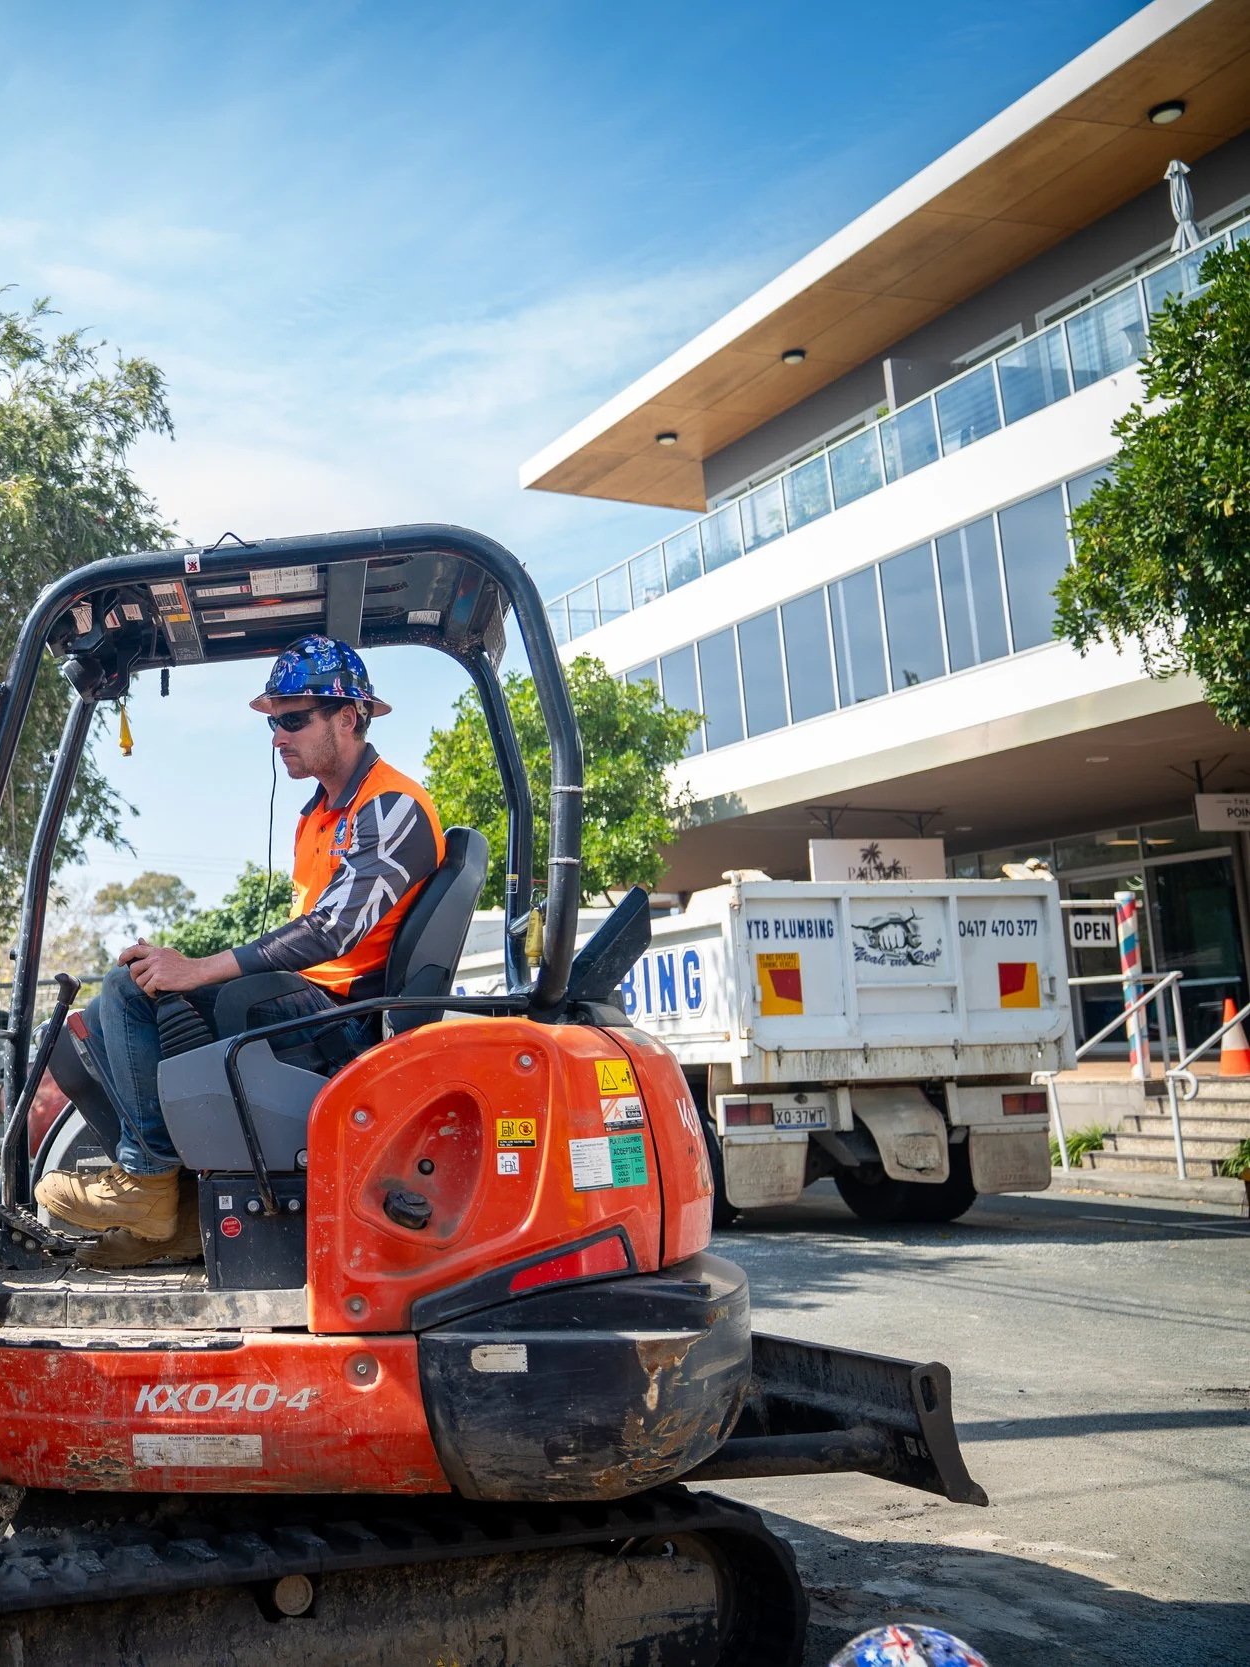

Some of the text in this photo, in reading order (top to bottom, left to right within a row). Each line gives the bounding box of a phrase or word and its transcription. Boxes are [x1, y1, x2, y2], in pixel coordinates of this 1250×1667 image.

[746, 919, 834, 939] YTB PLUMBING
[958, 920, 1038, 937] 0417 470 377
[1074, 922, 1111, 940] OPEN
[621, 947, 704, 1017] BING
[614, 1146, 642, 1156] ACCEPTANCE
[135, 1384, 311, 1412] KX040-4
